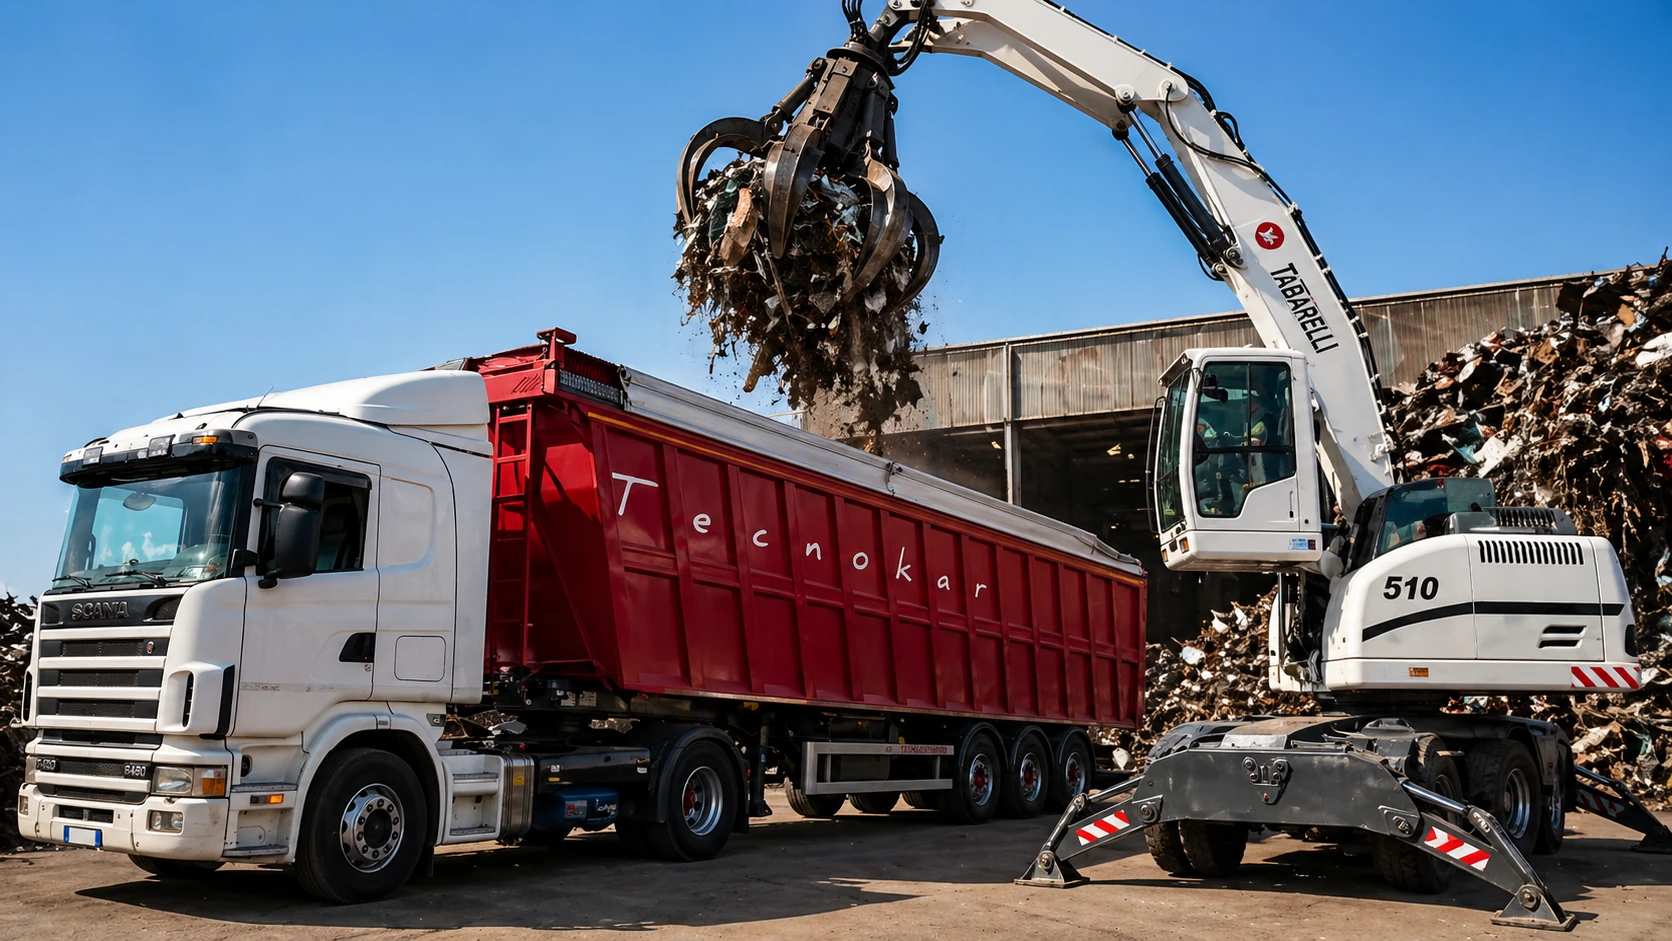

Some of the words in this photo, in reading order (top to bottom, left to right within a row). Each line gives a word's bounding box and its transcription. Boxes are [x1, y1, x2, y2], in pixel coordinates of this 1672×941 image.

[1270, 263, 1339, 354] TABARELLI
[612, 472, 987, 598] Tecnokar
[1383, 576, 1439, 600] 510
